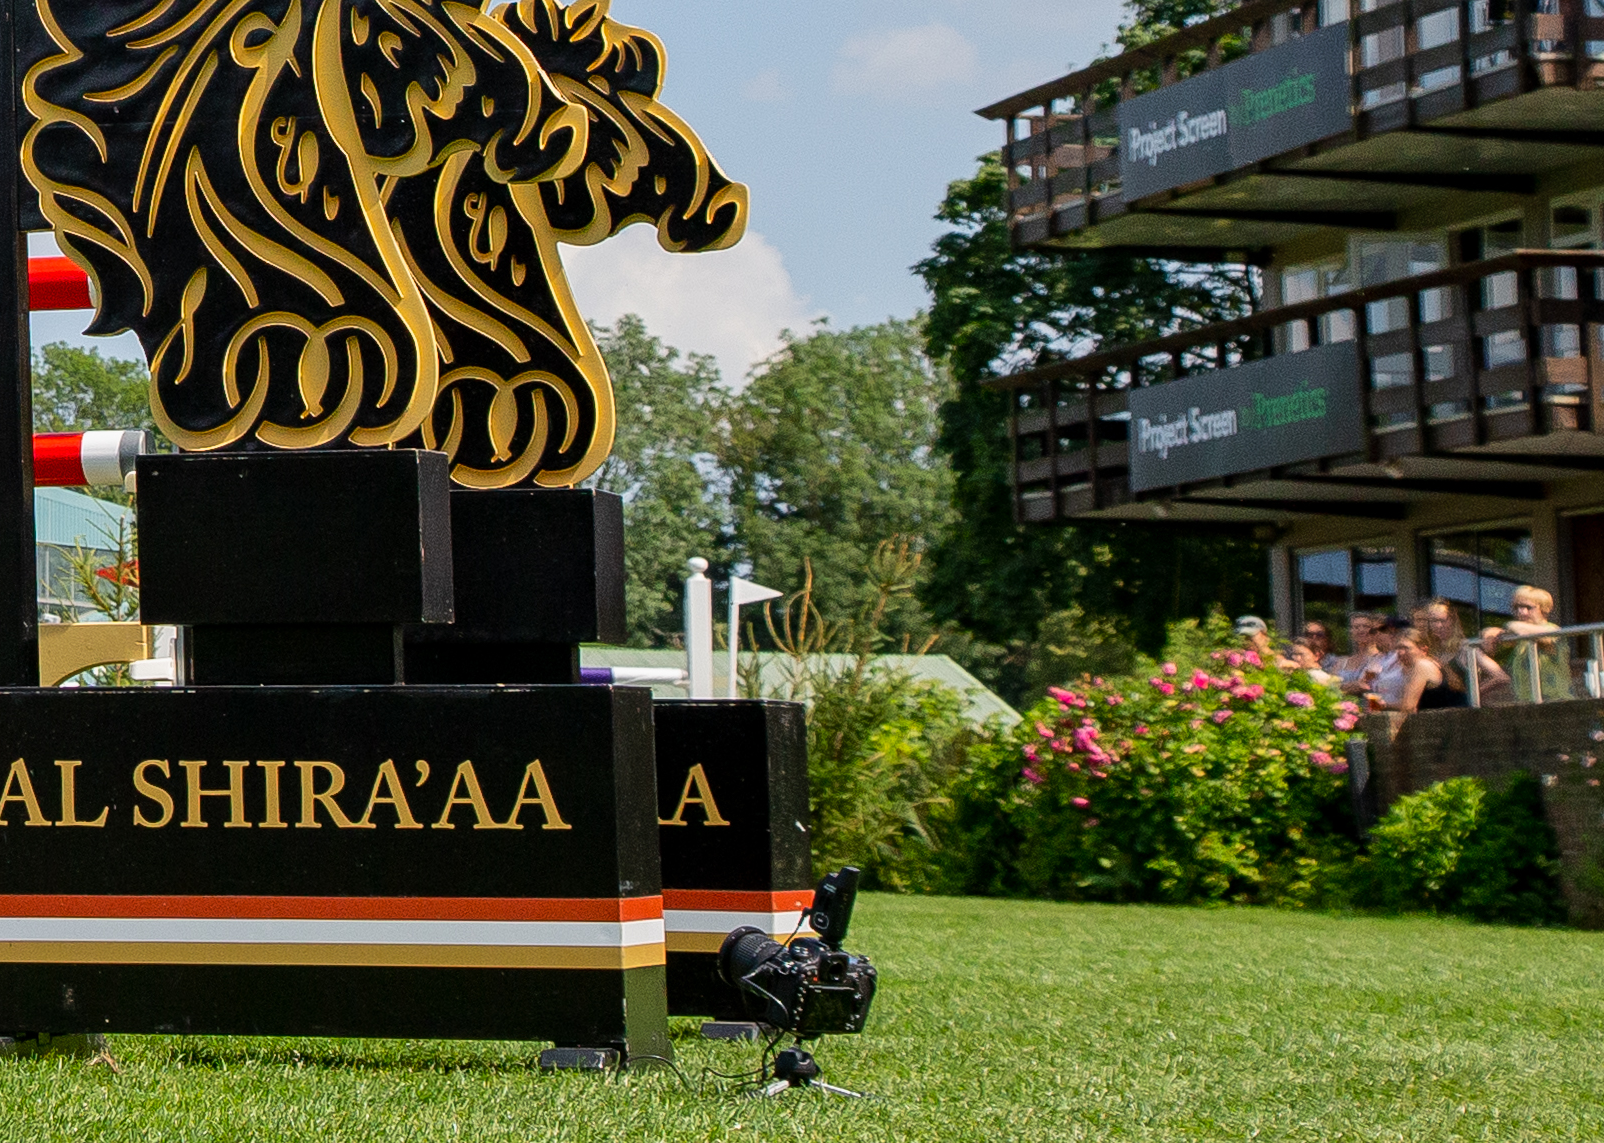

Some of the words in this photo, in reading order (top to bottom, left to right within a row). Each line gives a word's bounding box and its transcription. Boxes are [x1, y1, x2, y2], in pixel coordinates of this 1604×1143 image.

[1128, 118, 1177, 167] Project
[1175, 109, 1227, 147] Screen
[1137, 412, 1189, 460] Project
[1188, 406, 1238, 444] Screen
